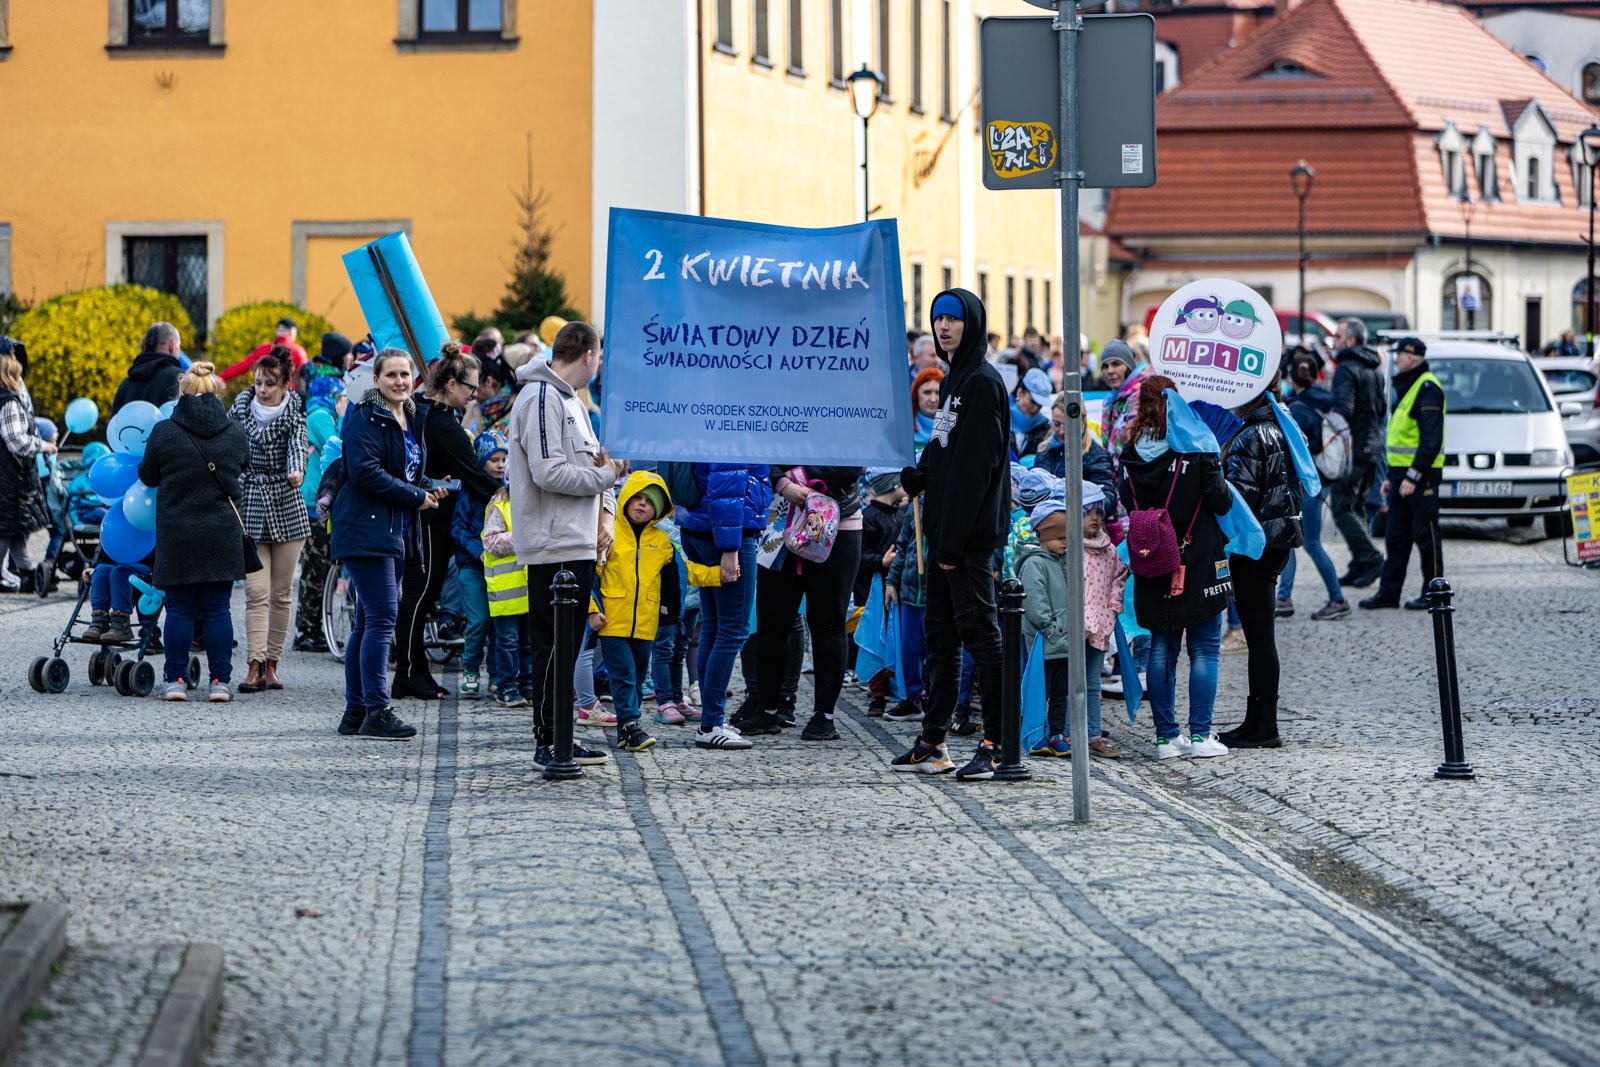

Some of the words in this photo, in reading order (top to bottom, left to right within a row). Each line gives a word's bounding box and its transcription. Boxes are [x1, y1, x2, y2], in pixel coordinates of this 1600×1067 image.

[643, 248, 666, 281] 2
[680, 249, 871, 291] KWIETNIA
[643, 313, 781, 349] ŚWIATOWY
[792, 317, 871, 350] DZIEŃ
[643, 347, 772, 370] ŚWIADOMOŚCI
[780, 355, 870, 372] AUTYZMU
[1164, 338, 1260, 373] MP10
[1163, 369, 1192, 380] Miejskie
[1193, 373, 1235, 387] Przedszkole
[1187, 380, 1214, 391] Jeleniej
[624, 401, 689, 415] SPECJALNY
[690, 401, 746, 417] OŚRODEK
[748, 405, 888, 420] SZKOLNO-WYCHOWAWCZY
[704, 419, 716, 431] W
[718, 419, 768, 432] JELENIEJ
[770, 419, 809, 433] GÓRZE
[1203, 581, 1232, 598] PRETTY
